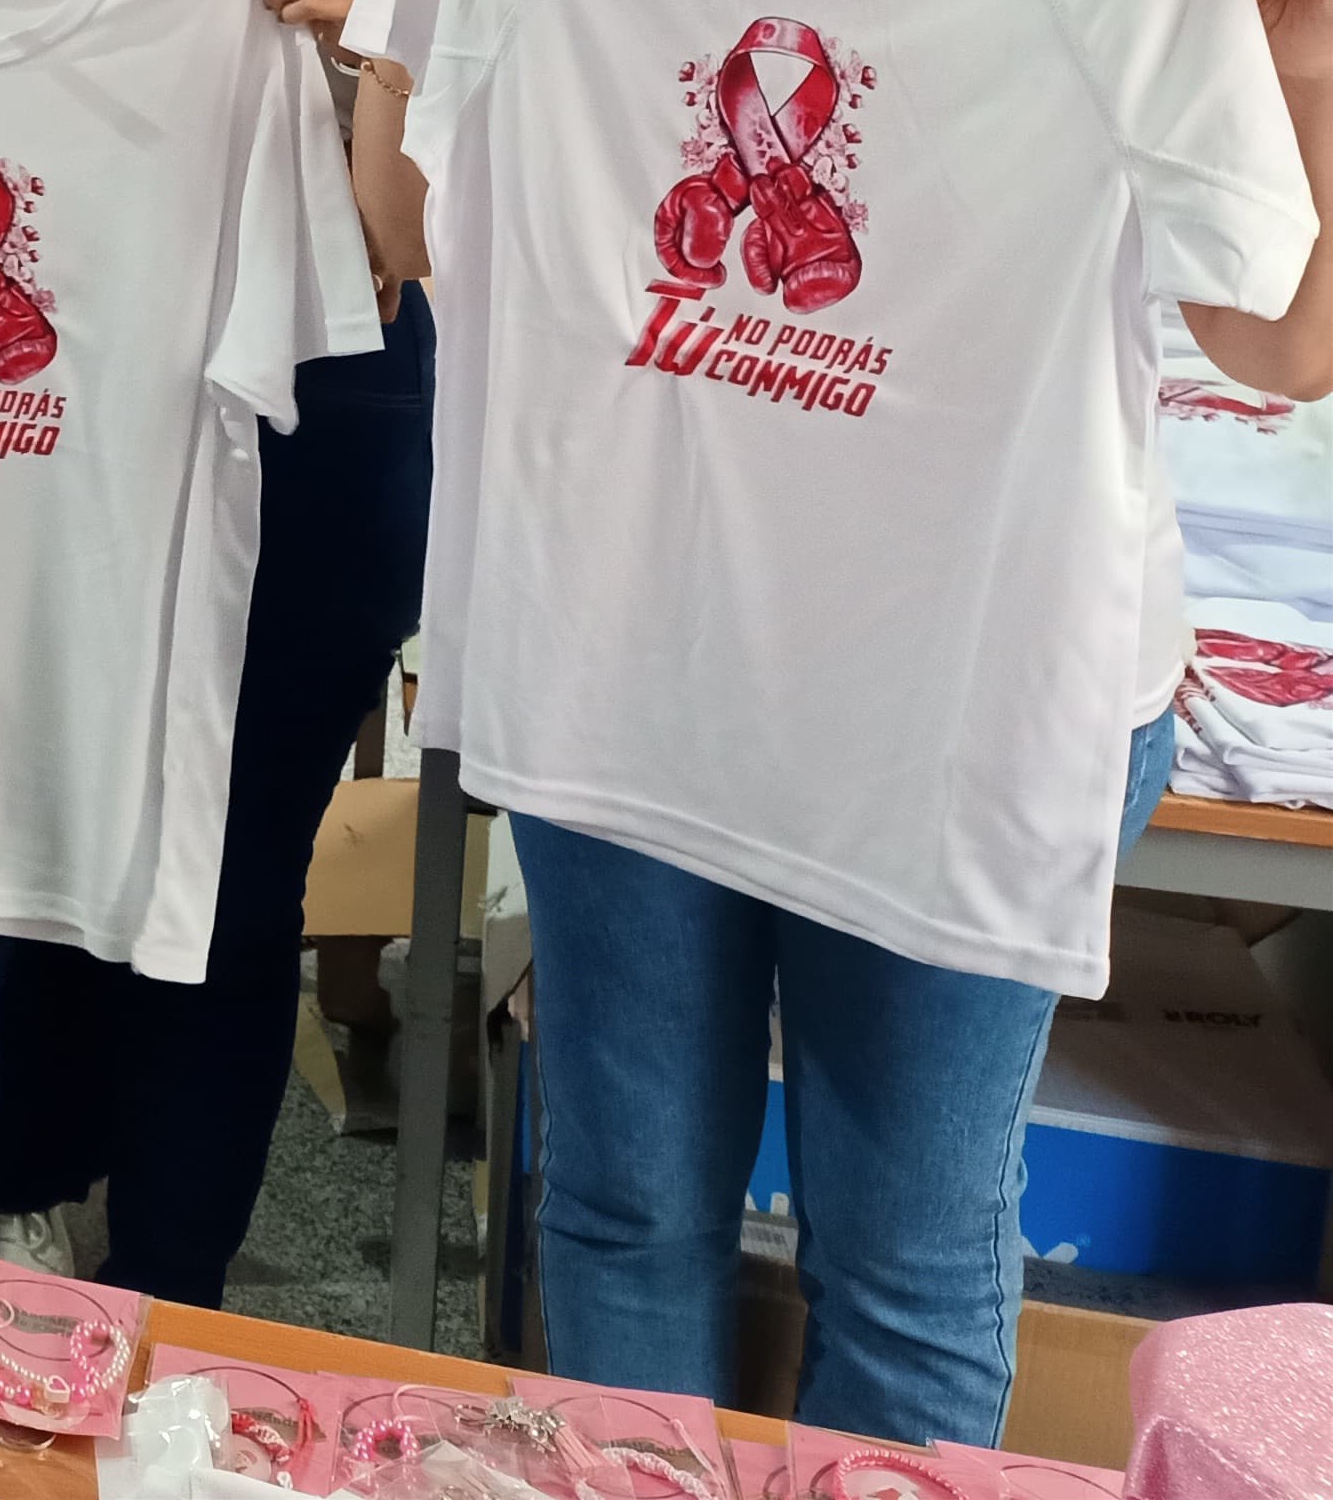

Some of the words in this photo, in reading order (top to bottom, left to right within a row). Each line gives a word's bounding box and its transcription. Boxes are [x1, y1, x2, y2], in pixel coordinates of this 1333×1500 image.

[722, 313, 771, 345] NO
[767, 324, 893, 375] PODRÁS
[705, 349, 876, 417] CONMIGO
